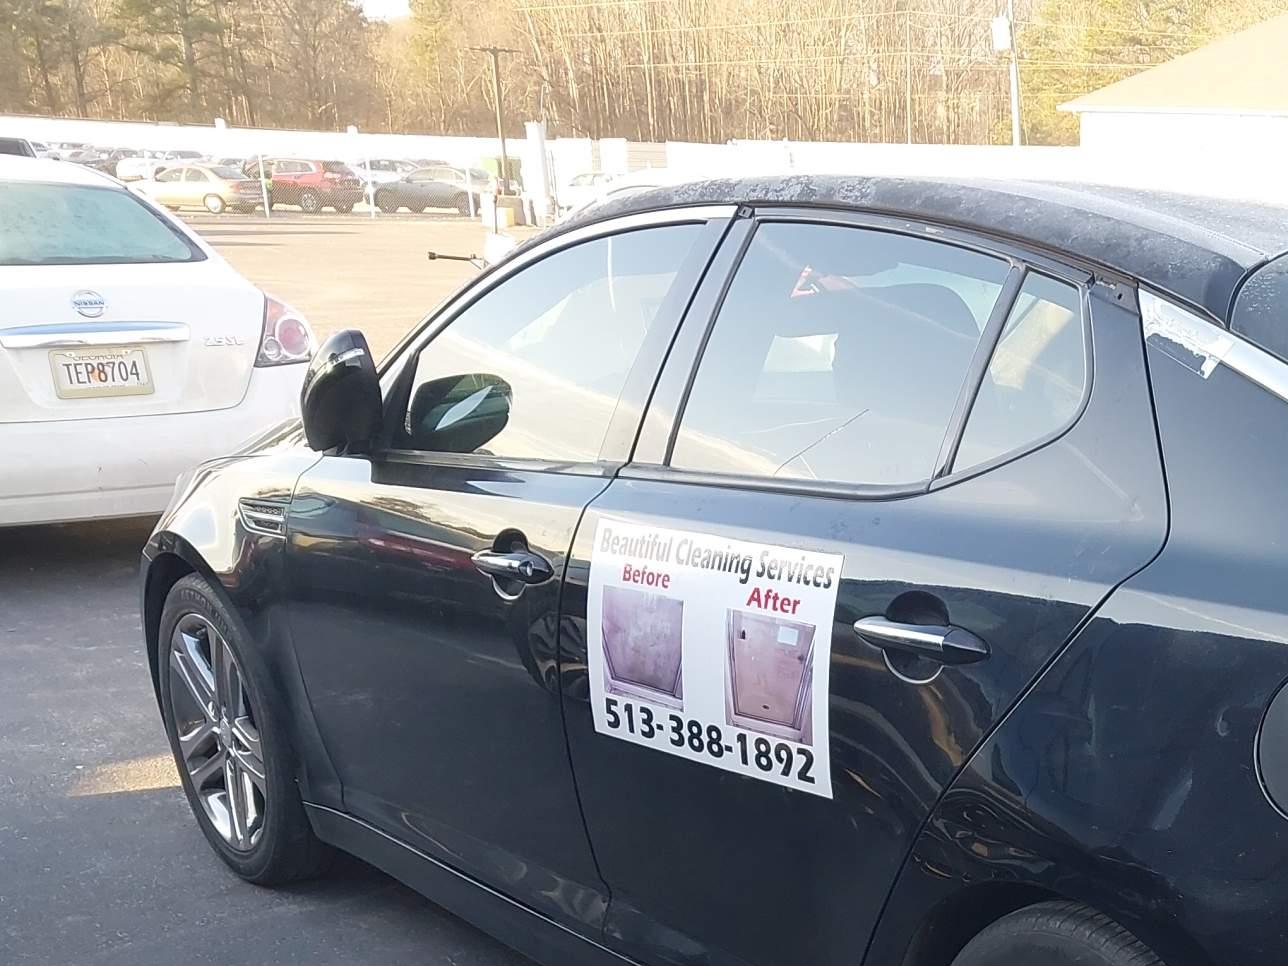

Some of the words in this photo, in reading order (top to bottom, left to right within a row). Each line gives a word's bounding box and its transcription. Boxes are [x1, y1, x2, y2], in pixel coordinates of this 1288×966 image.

[62, 360, 140, 384] TEP8704
[600, 527, 672, 562] Beautiful
[675, 538, 752, 584] Cleaning
[756, 550, 834, 589] Services
[622, 564, 671, 589] Before
[746, 587, 800, 615] After
[605, 698, 816, 785] 513-388-1892
